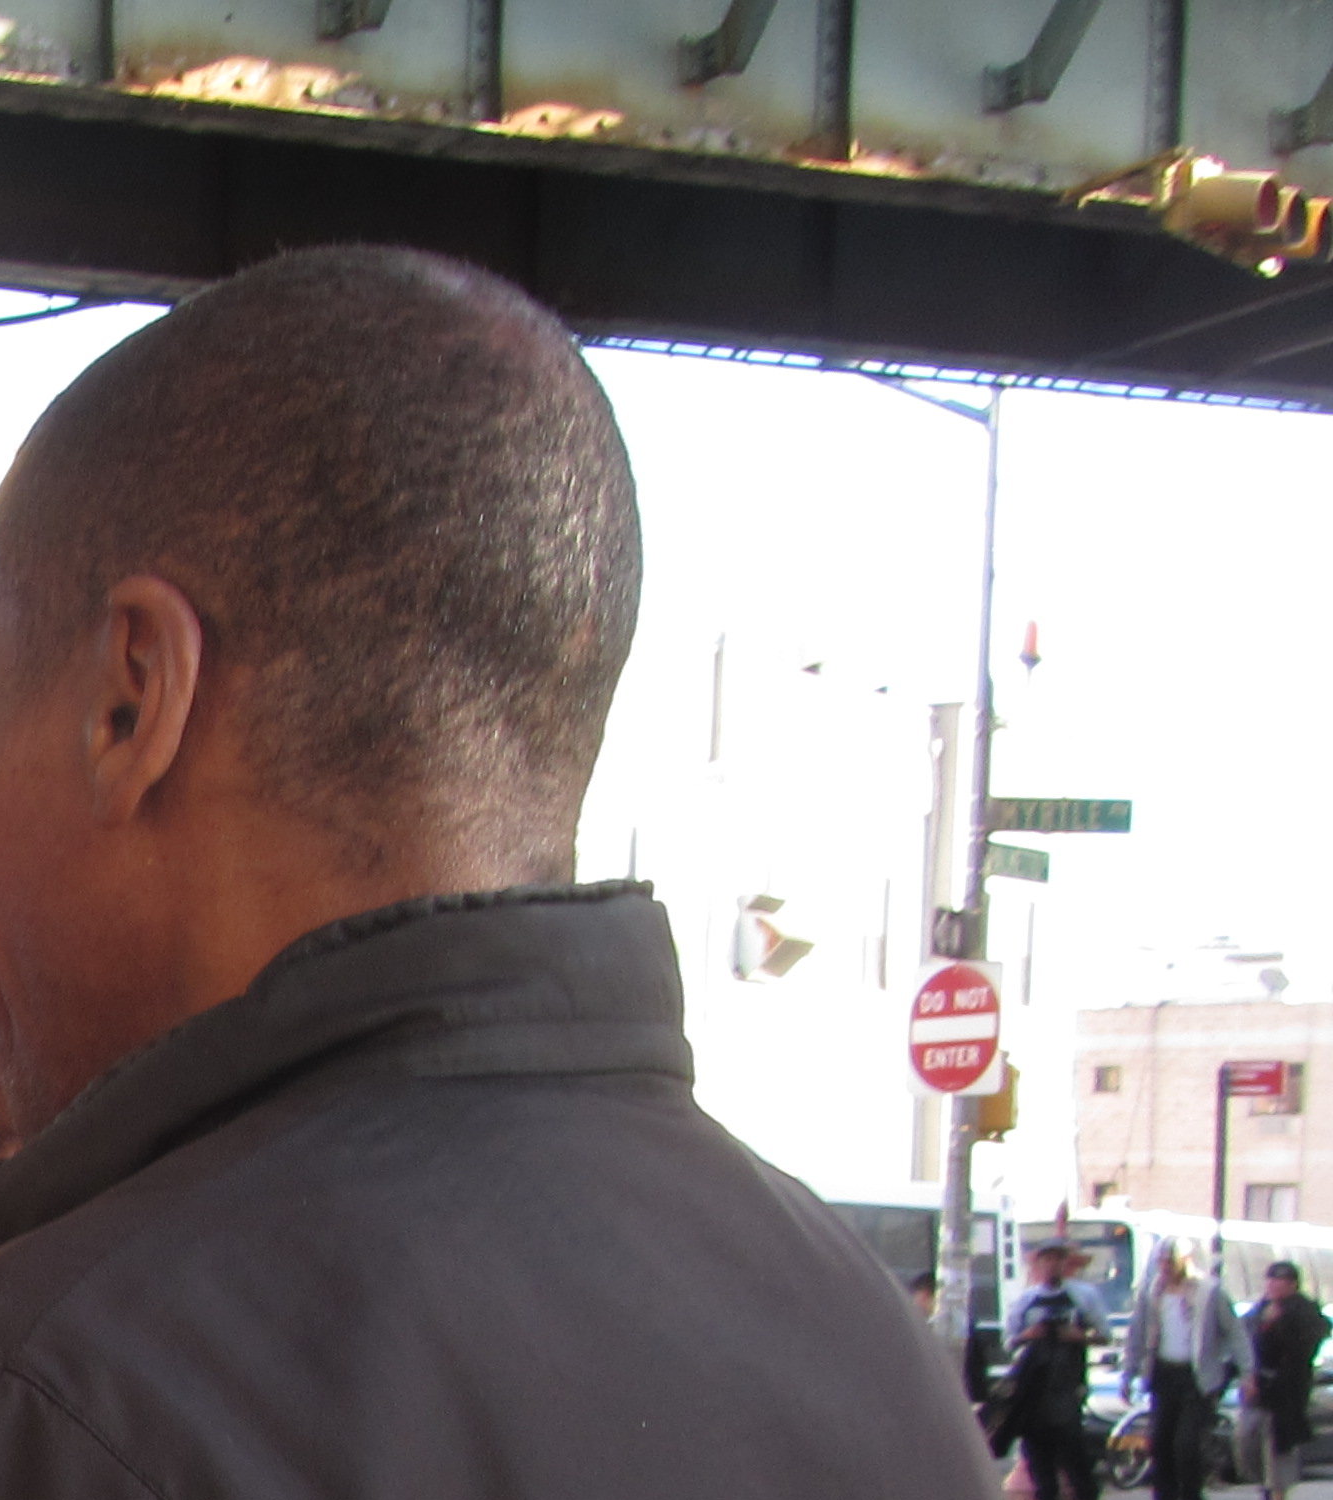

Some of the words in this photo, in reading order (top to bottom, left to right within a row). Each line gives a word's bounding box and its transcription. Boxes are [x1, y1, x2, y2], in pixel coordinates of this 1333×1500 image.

[1000, 801, 1102, 830] MYRTLE
[919, 990, 946, 1014] DO
[953, 986, 989, 1011] NOT
[923, 1045, 981, 1069] ENTER
